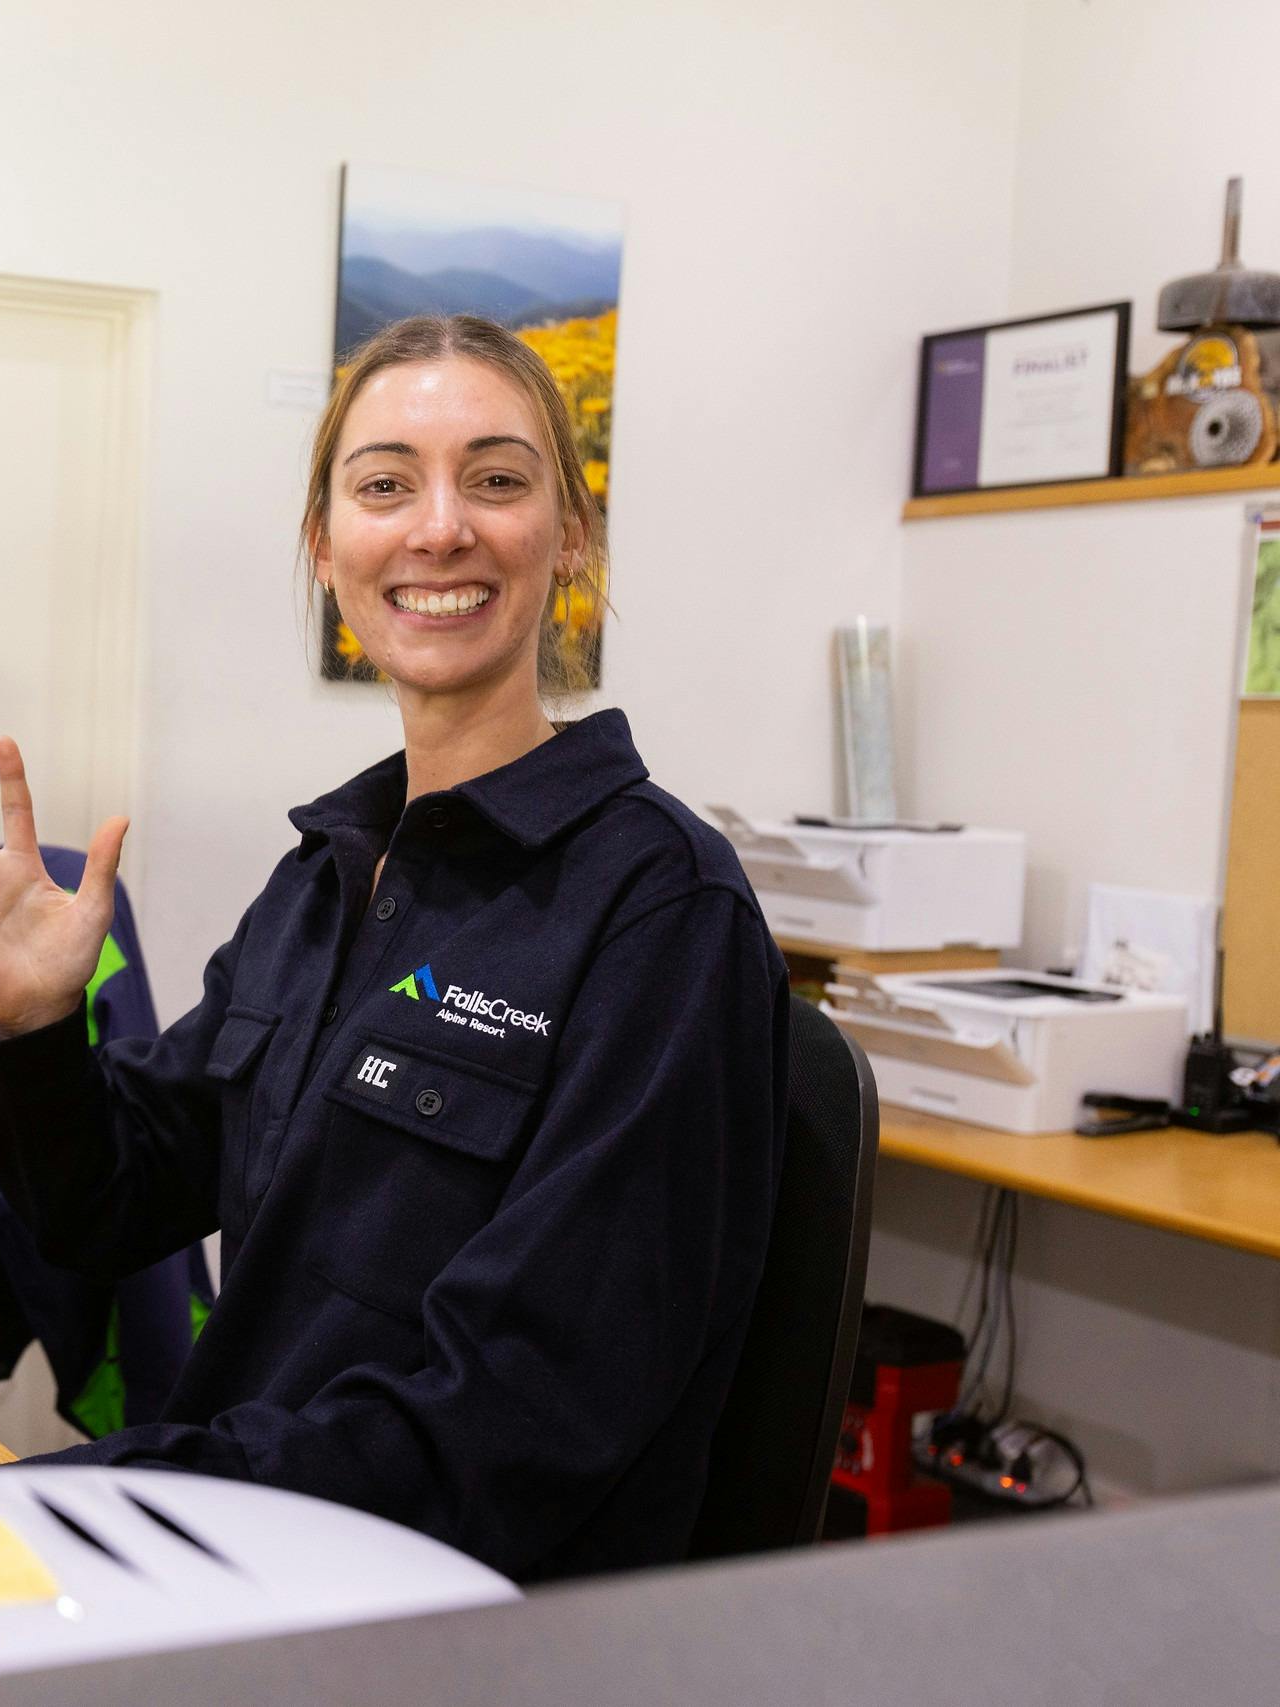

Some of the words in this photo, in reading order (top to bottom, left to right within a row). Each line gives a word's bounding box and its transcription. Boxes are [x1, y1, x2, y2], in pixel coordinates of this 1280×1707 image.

[436, 1008, 468, 1026] Alpine
[469, 1018, 506, 1038] Resort
[442, 984, 552, 1036] FallsCreek
[357, 1055, 397, 1089] HC
